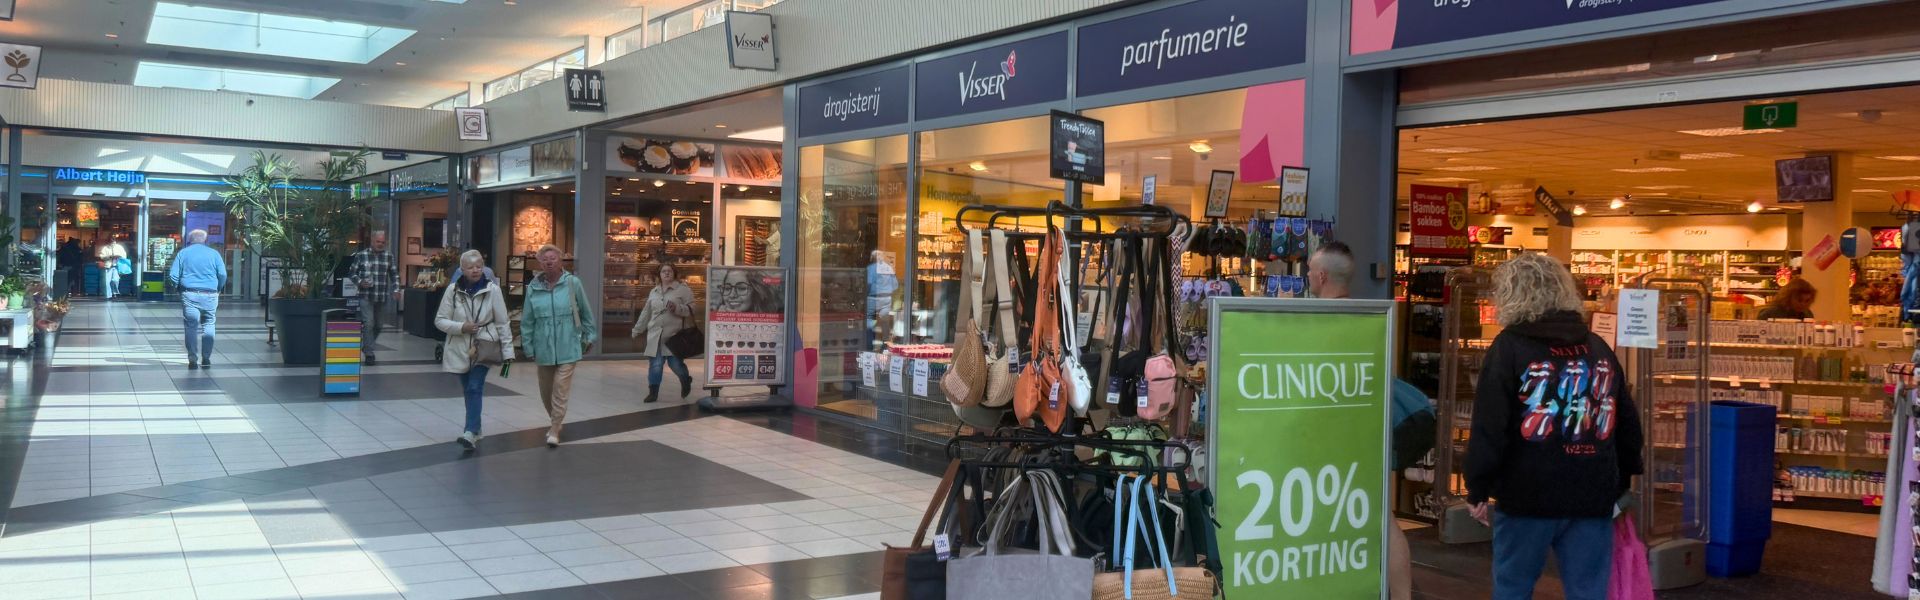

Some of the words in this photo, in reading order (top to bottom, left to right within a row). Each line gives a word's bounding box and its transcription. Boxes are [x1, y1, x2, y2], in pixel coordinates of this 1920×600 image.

[1121, 15, 1248, 76] parfumerie
[959, 60, 1006, 106] VISSER
[824, 86, 880, 121] drogisterij
[56, 168, 103, 181] Albert
[107, 170, 145, 185] Heijn
[1412, 201, 1446, 215] Bamboe
[1416, 216, 1443, 227] sokken
[716, 365, 732, 374] €49
[738, 365, 753, 374] €99
[759, 365, 775, 374] €149
[1237, 362, 1375, 403] CLINIQUE
[1235, 462, 1369, 541] 20%
[1233, 537, 1368, 587] KORTING
